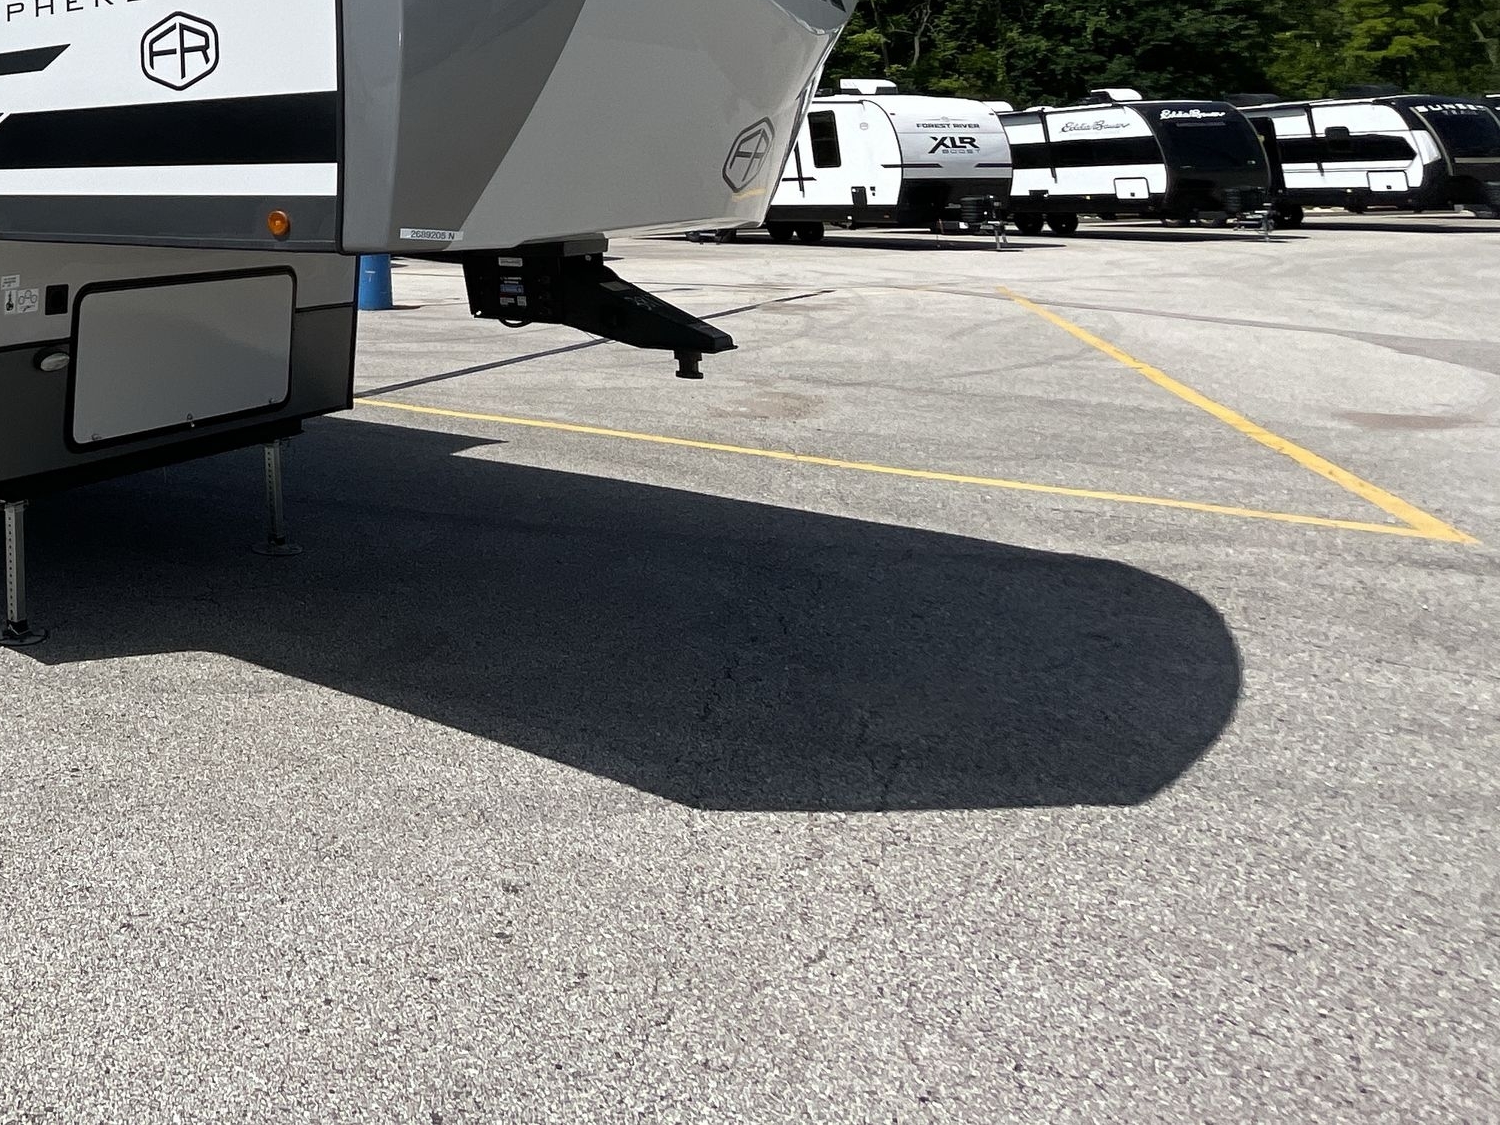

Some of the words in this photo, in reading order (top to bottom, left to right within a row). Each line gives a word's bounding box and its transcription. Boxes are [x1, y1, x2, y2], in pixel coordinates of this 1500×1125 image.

[148, 22, 210, 79] FR
[928, 136, 980, 154] XLR
[448, 232, 455, 240] N
